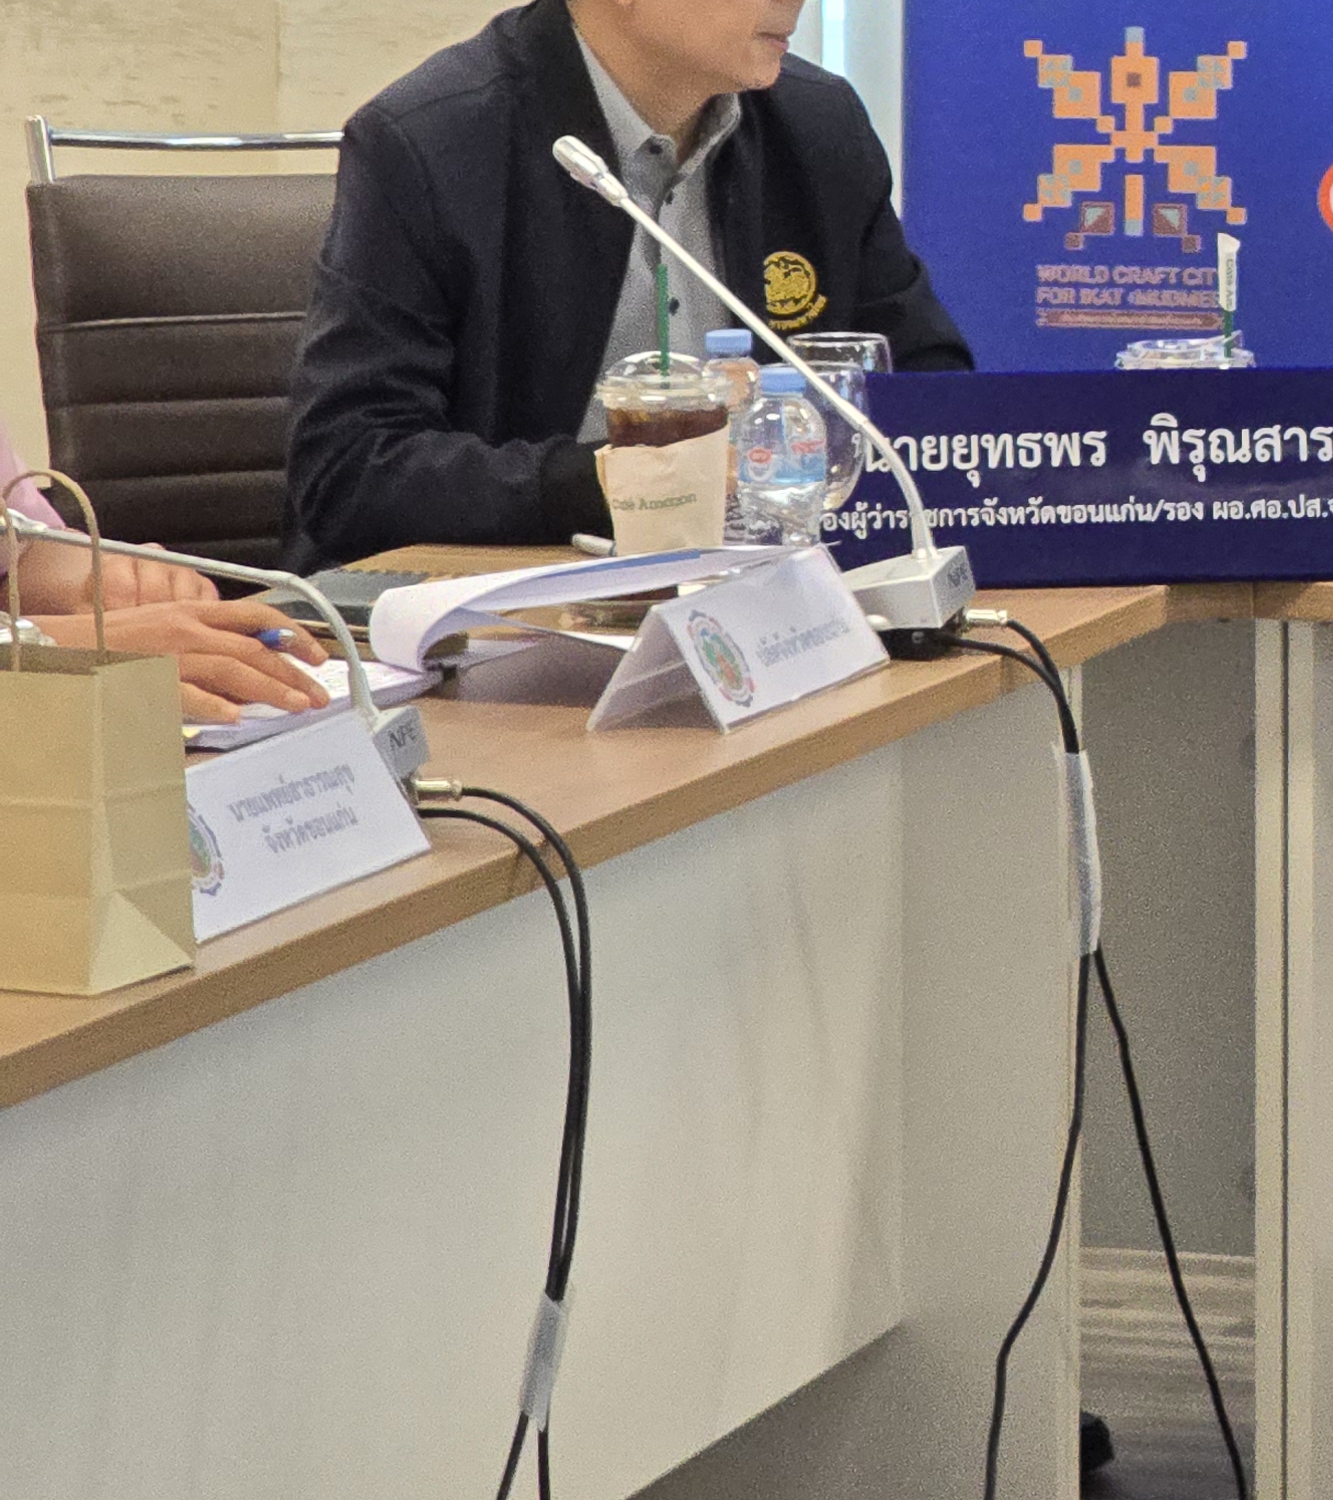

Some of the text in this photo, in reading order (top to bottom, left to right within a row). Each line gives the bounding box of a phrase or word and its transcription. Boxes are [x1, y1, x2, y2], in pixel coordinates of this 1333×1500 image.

[1112, 266, 1182, 285] CRAFT
[1182, 266, 1218, 286] CIT
[1036, 286, 1076, 305] FOR
[820, 495, 1204, 540] องผู้ว่ารชการจังหวัดขอนแก่น/รอง
